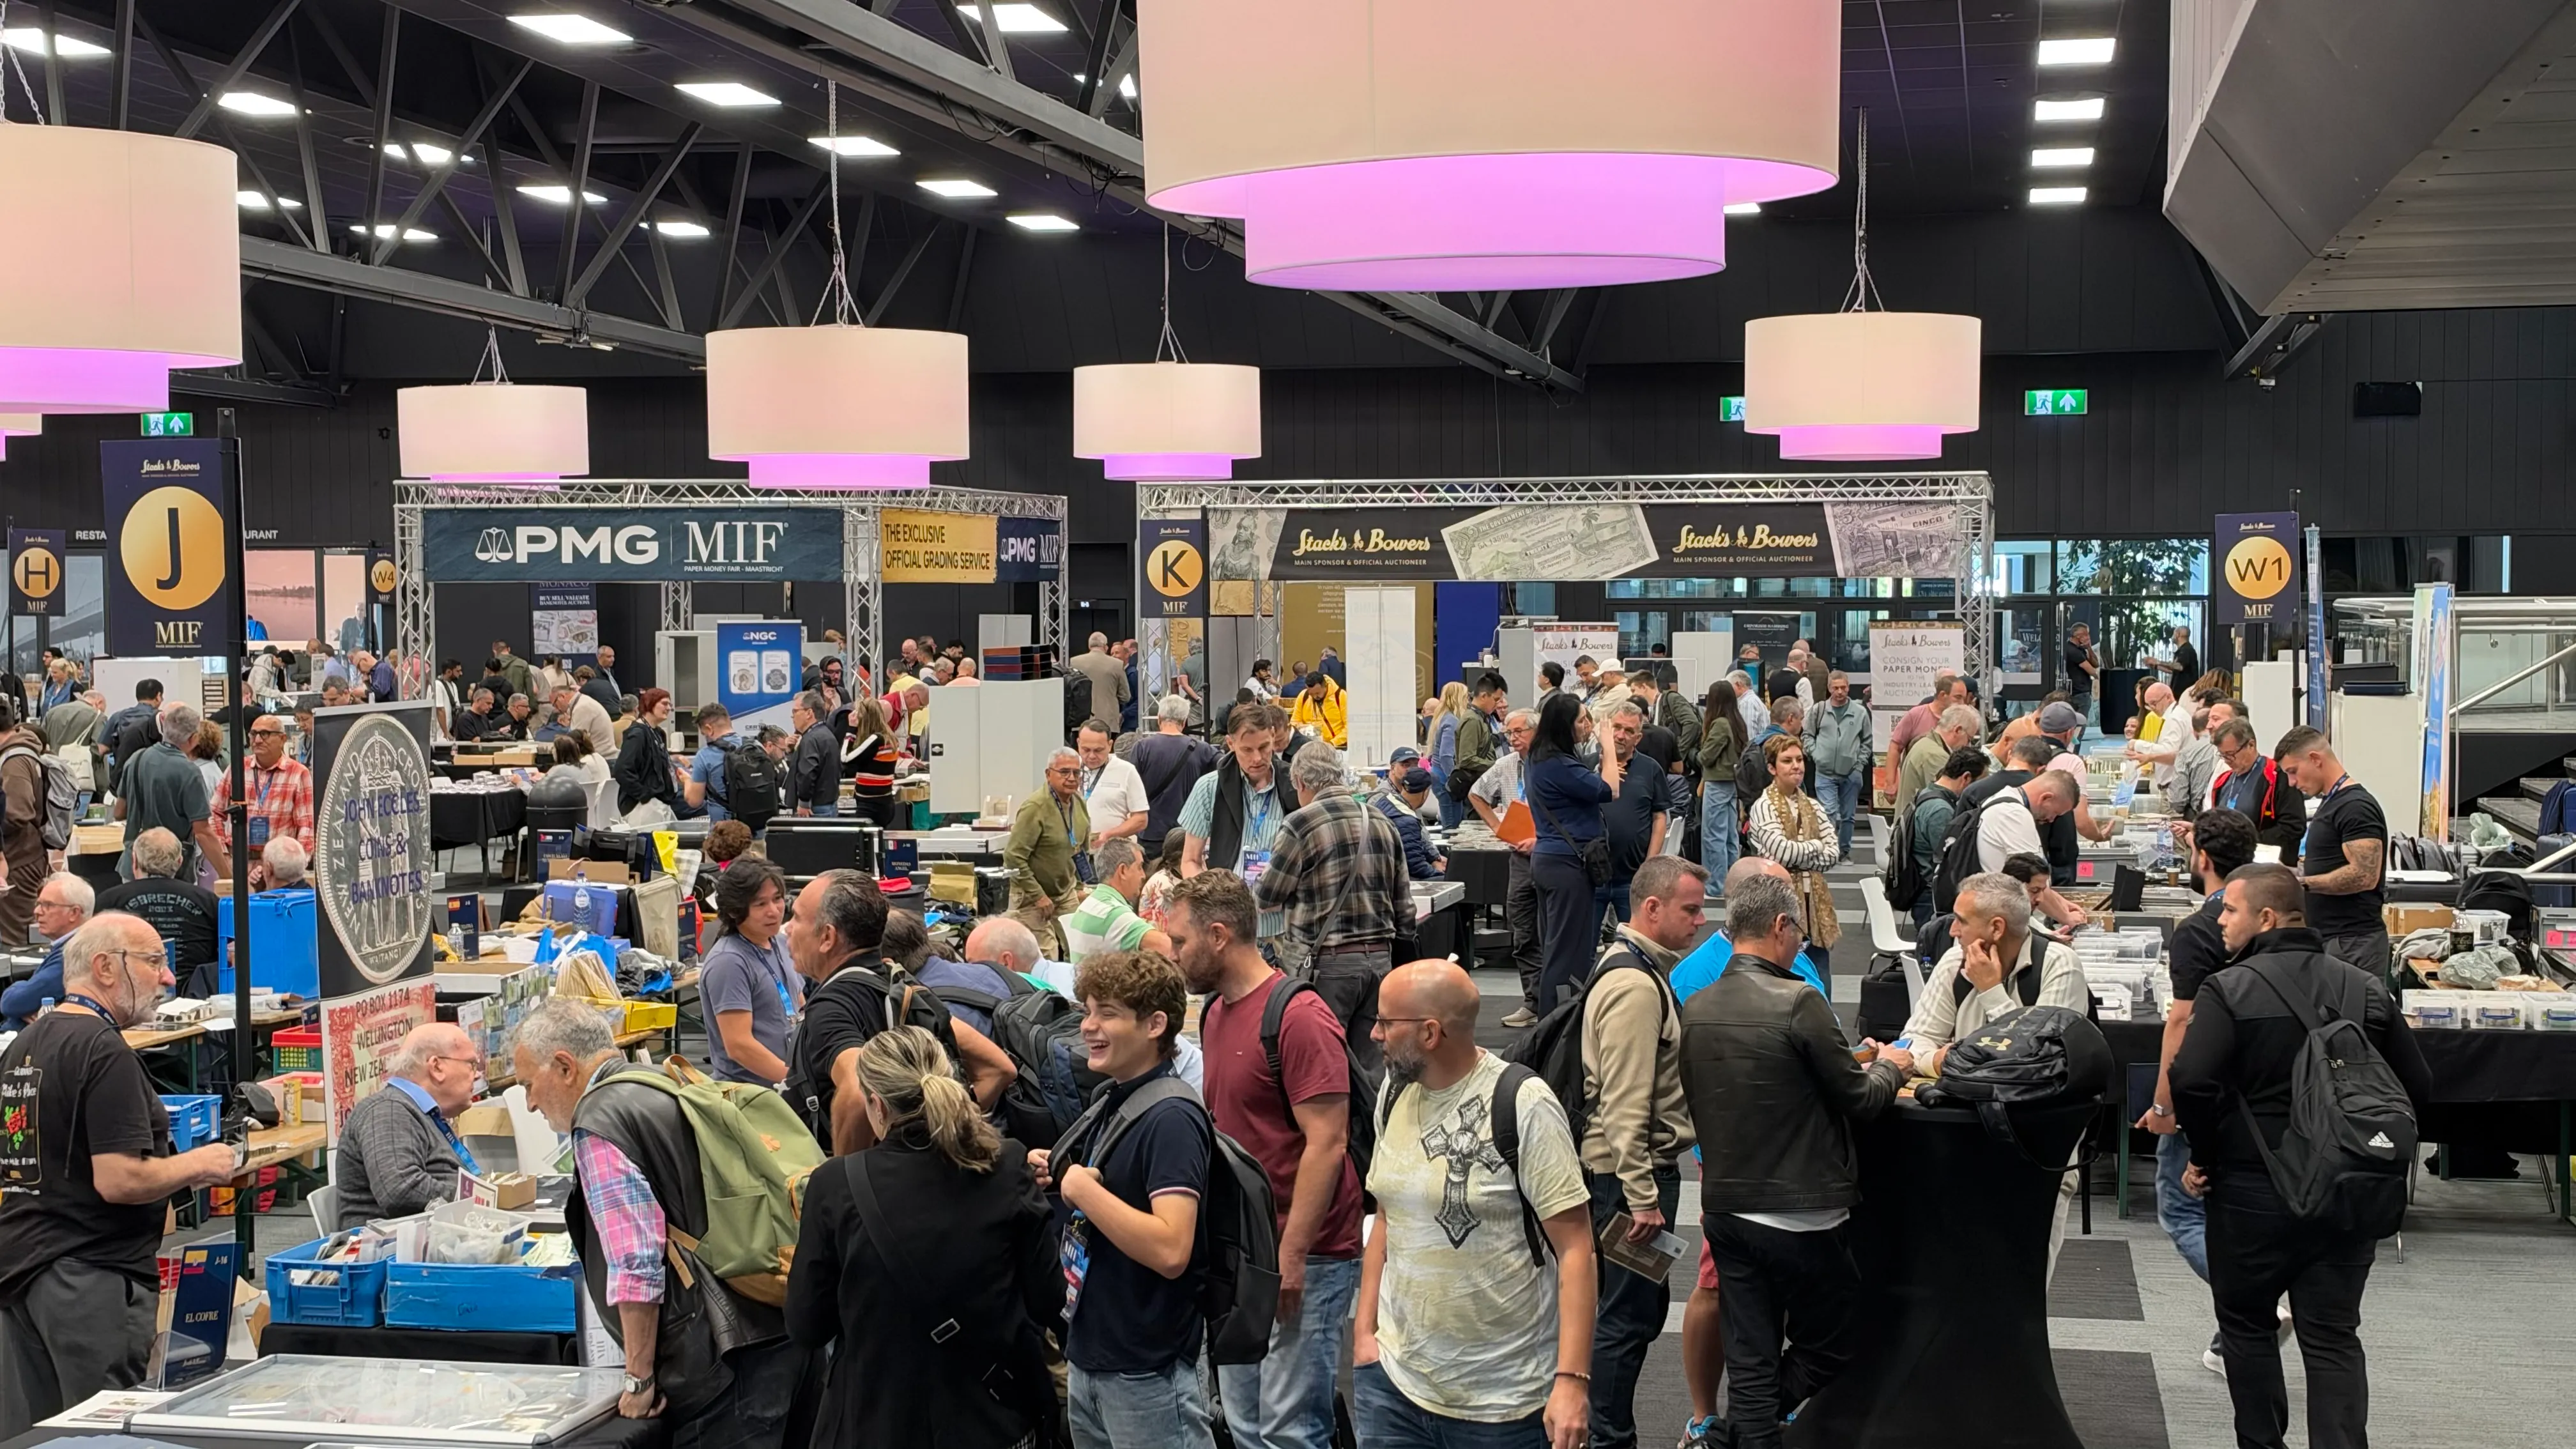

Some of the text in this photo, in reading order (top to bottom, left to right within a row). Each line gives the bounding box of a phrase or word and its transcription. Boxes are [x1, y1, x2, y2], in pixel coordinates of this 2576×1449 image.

[1479, 525, 1489, 533] THE
[1489, 510, 1525, 529] GOVERNMENT
[1912, 514, 1943, 529] CINCO
[75, 530, 107, 540] RESTA
[245, 530, 279, 540] URANT
[516, 525, 659, 565] PMG
[684, 521, 784, 563] MIF
[884, 523, 946, 544] THE EXCLUSIVE
[1292, 528, 1347, 556] Stack's
[1364, 528, 1430, 553] Bowers
[1547, 533, 1573, 548] DOLLARS
[1672, 524, 1730, 553] Stack's
[1748, 524, 1818, 549] Bowers
[157, 507, 183, 591] J
[885, 549, 990, 570] OFFICIAL GRADING SERVICE
[1008, 537, 1036, 563] PMG
[1039, 534, 1059, 563] MIF
[24, 556, 50, 590] H
[373, 571, 394, 584] W4
[1162, 549, 1190, 588] K
[2232, 556, 2283, 583] W1
[26, 601, 47, 611] MIF
[1162, 601, 1188, 613] MIF
[2243, 604, 2273, 617] MIF
[154, 621, 202, 644] MIF
[750, 631, 777, 640] NGC
[1919, 634, 1951, 647] Bowers
[2022, 632, 2041, 642] WELC
[1538, 638, 1568, 652] Stack's
[1579, 638, 1613, 650] Bowers
[1882, 656, 1950, 664] CONSIGN YOUR
[1915, 665, 1949, 673] MON
[344, 790, 420, 824] JOHN ECCLES
[359, 832, 407, 861] COINS &
[351, 870, 422, 905] BANKNOTES
[356, 987, 410, 1018] PO BOX 1174
[356, 1017, 413, 1051] WELLINGTON
[345, 1062, 367, 1089] NEW
[185, 1310, 220, 1323] EL COFRE
